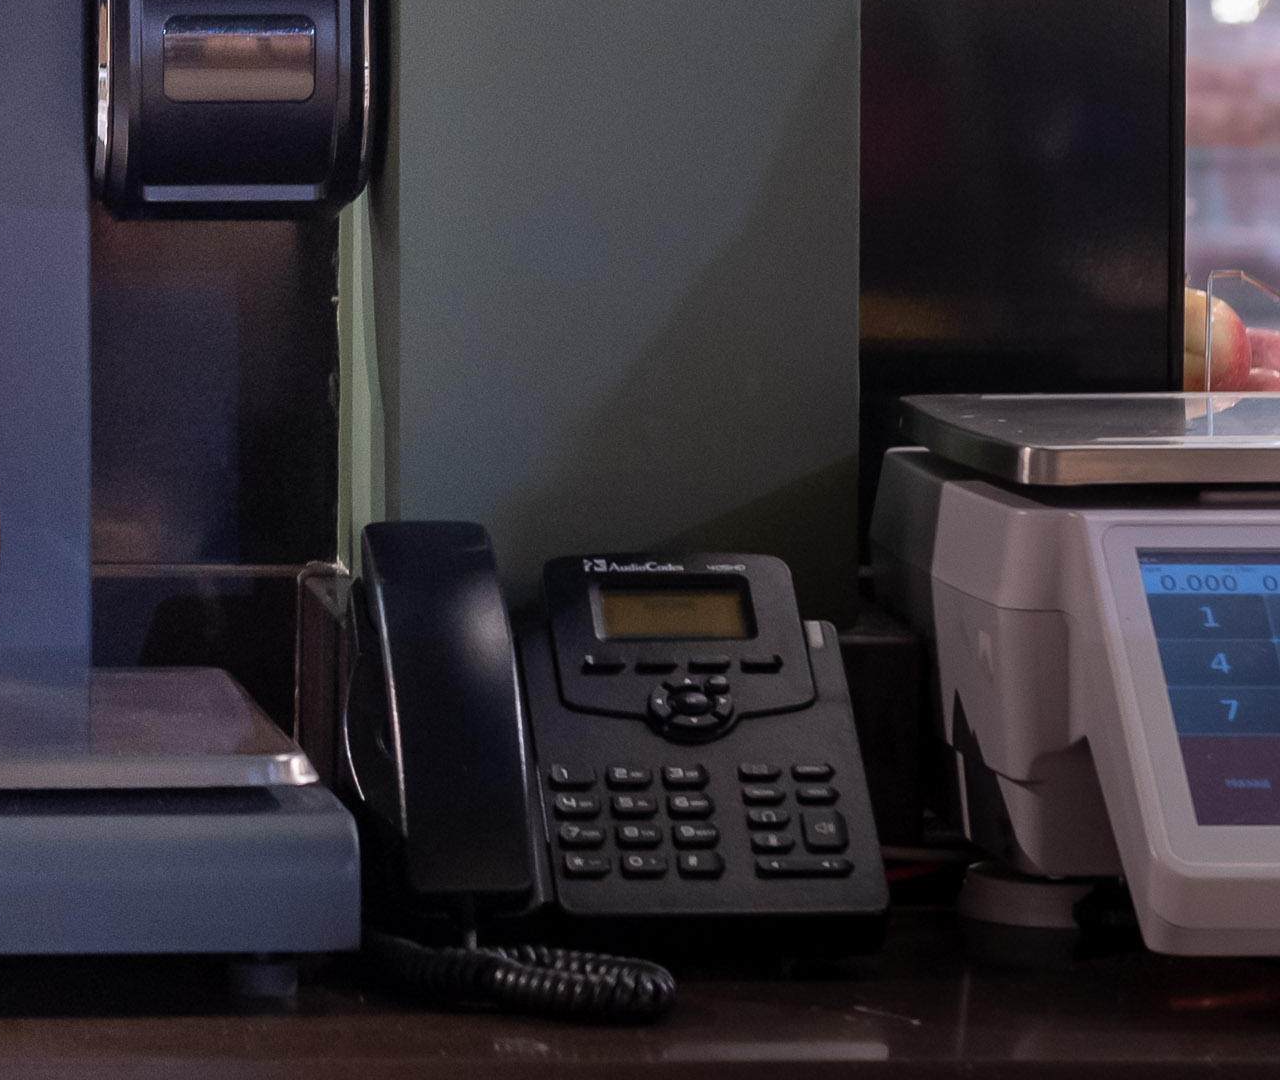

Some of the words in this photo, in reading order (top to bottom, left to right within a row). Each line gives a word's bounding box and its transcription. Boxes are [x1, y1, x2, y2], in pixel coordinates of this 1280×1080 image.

[608, 561, 685, 572] AudioCodes
[1159, 574, 1239, 592] 0.000
[1199, 606, 1221, 628] 1
[1209, 652, 1232, 674] 4
[1220, 699, 1239, 721] 7
